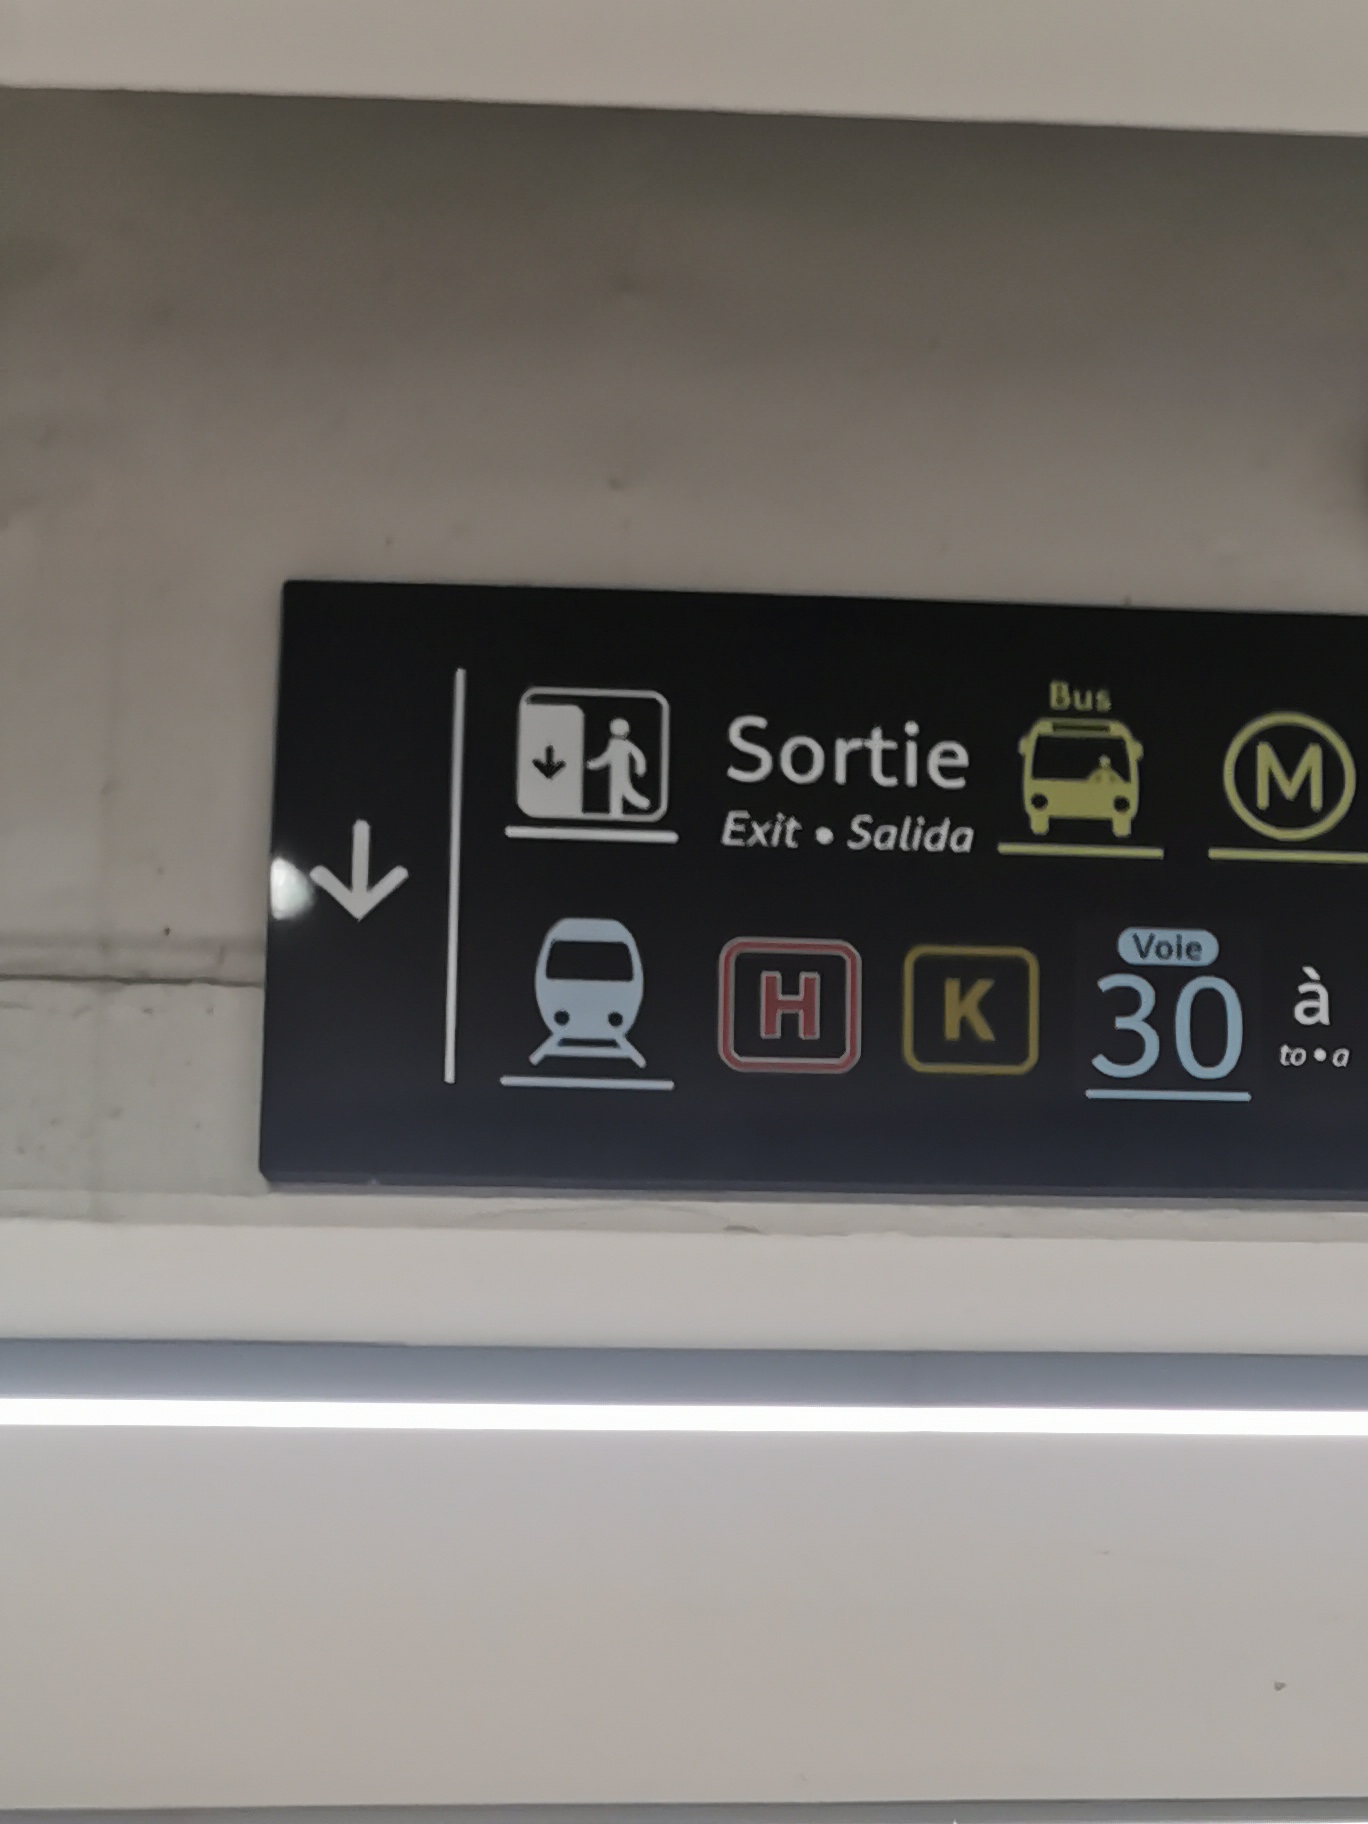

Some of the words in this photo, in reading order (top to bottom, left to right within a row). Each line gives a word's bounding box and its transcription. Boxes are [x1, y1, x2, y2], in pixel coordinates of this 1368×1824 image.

[1049, 680, 1112, 711] Bus
[727, 715, 969, 789] Sortie
[1256, 741, 1323, 812] M
[721, 810, 802, 848] Exit
[846, 814, 975, 854] Salida
[1131, 934, 1204, 962] Voie
[760, 971, 821, 1041] H
[944, 978, 996, 1043] K
[1091, 974, 1245, 1081] 30
[1294, 967, 1330, 1026] à
[1280, 1044, 1307, 1067] to
